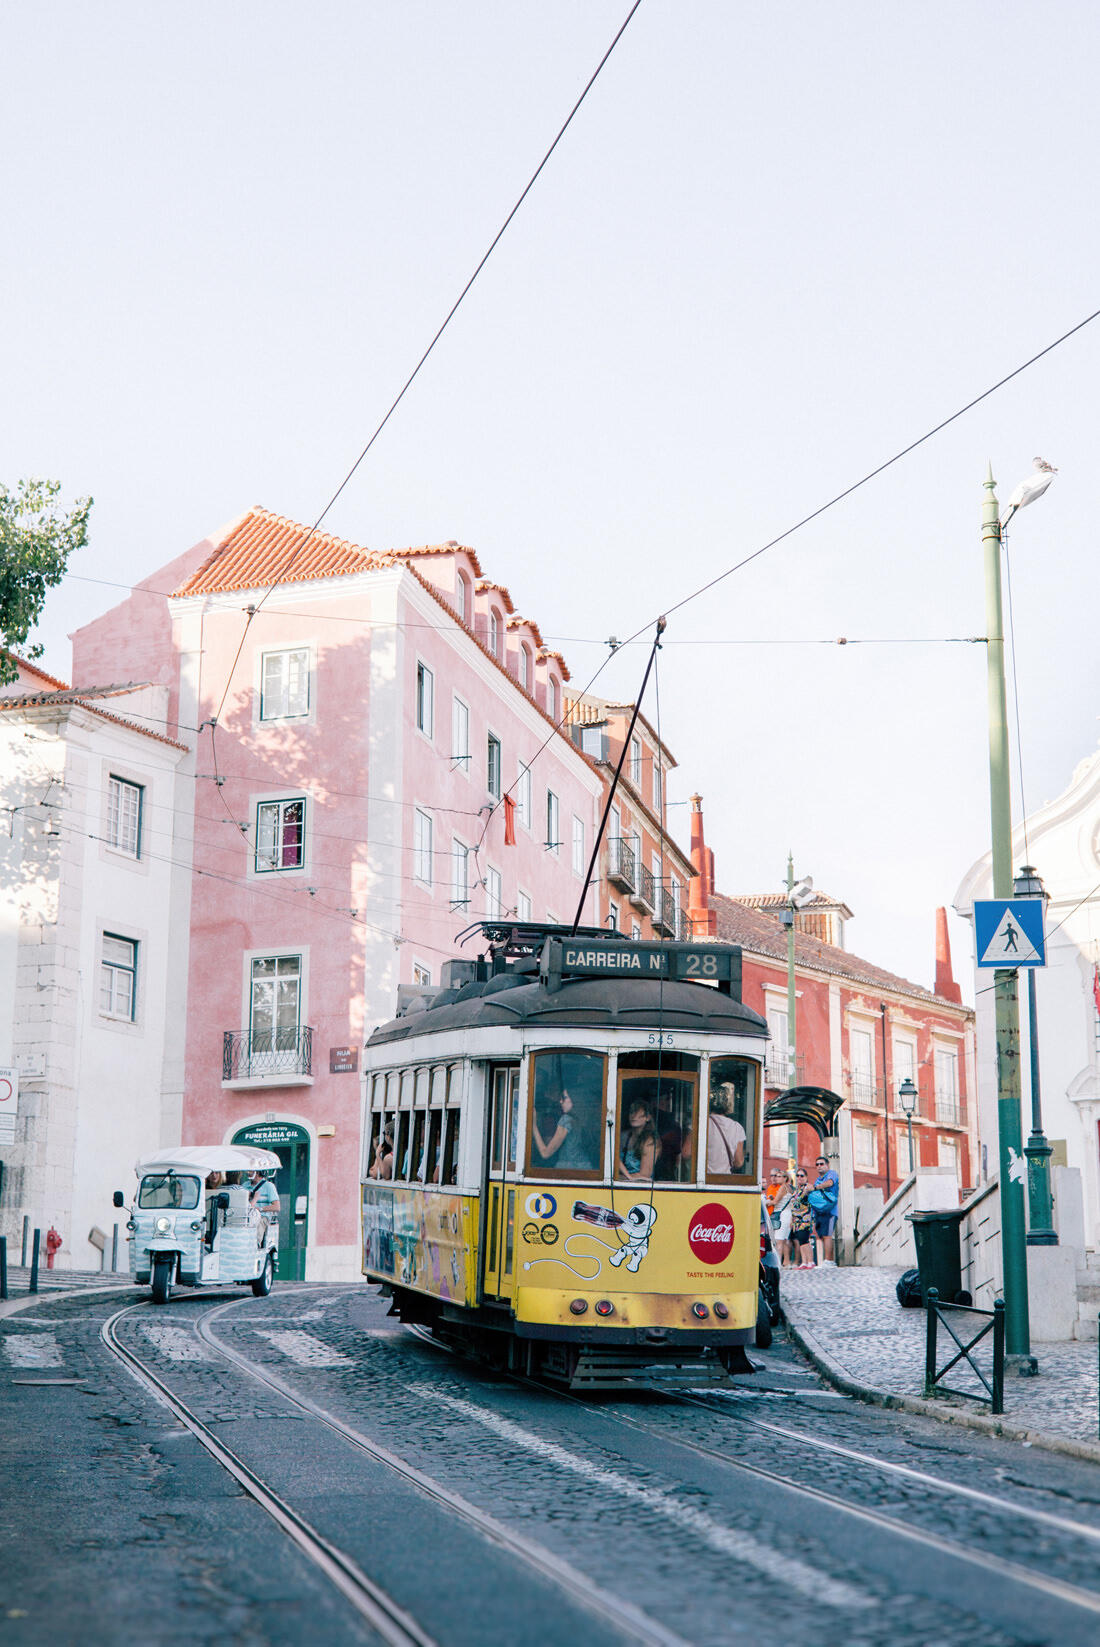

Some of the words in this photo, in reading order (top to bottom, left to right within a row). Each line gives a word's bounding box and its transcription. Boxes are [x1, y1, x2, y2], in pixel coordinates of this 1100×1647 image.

[566, 951, 641, 969] CARREIRA
[686, 954, 718, 975] 28
[648, 1033, 674, 1046] 545
[245, 1131, 285, 1140] FUNERÁRIA
[690, 1223, 734, 1243] Coca-Cola
[686, 1271, 703, 1279] TASTE
